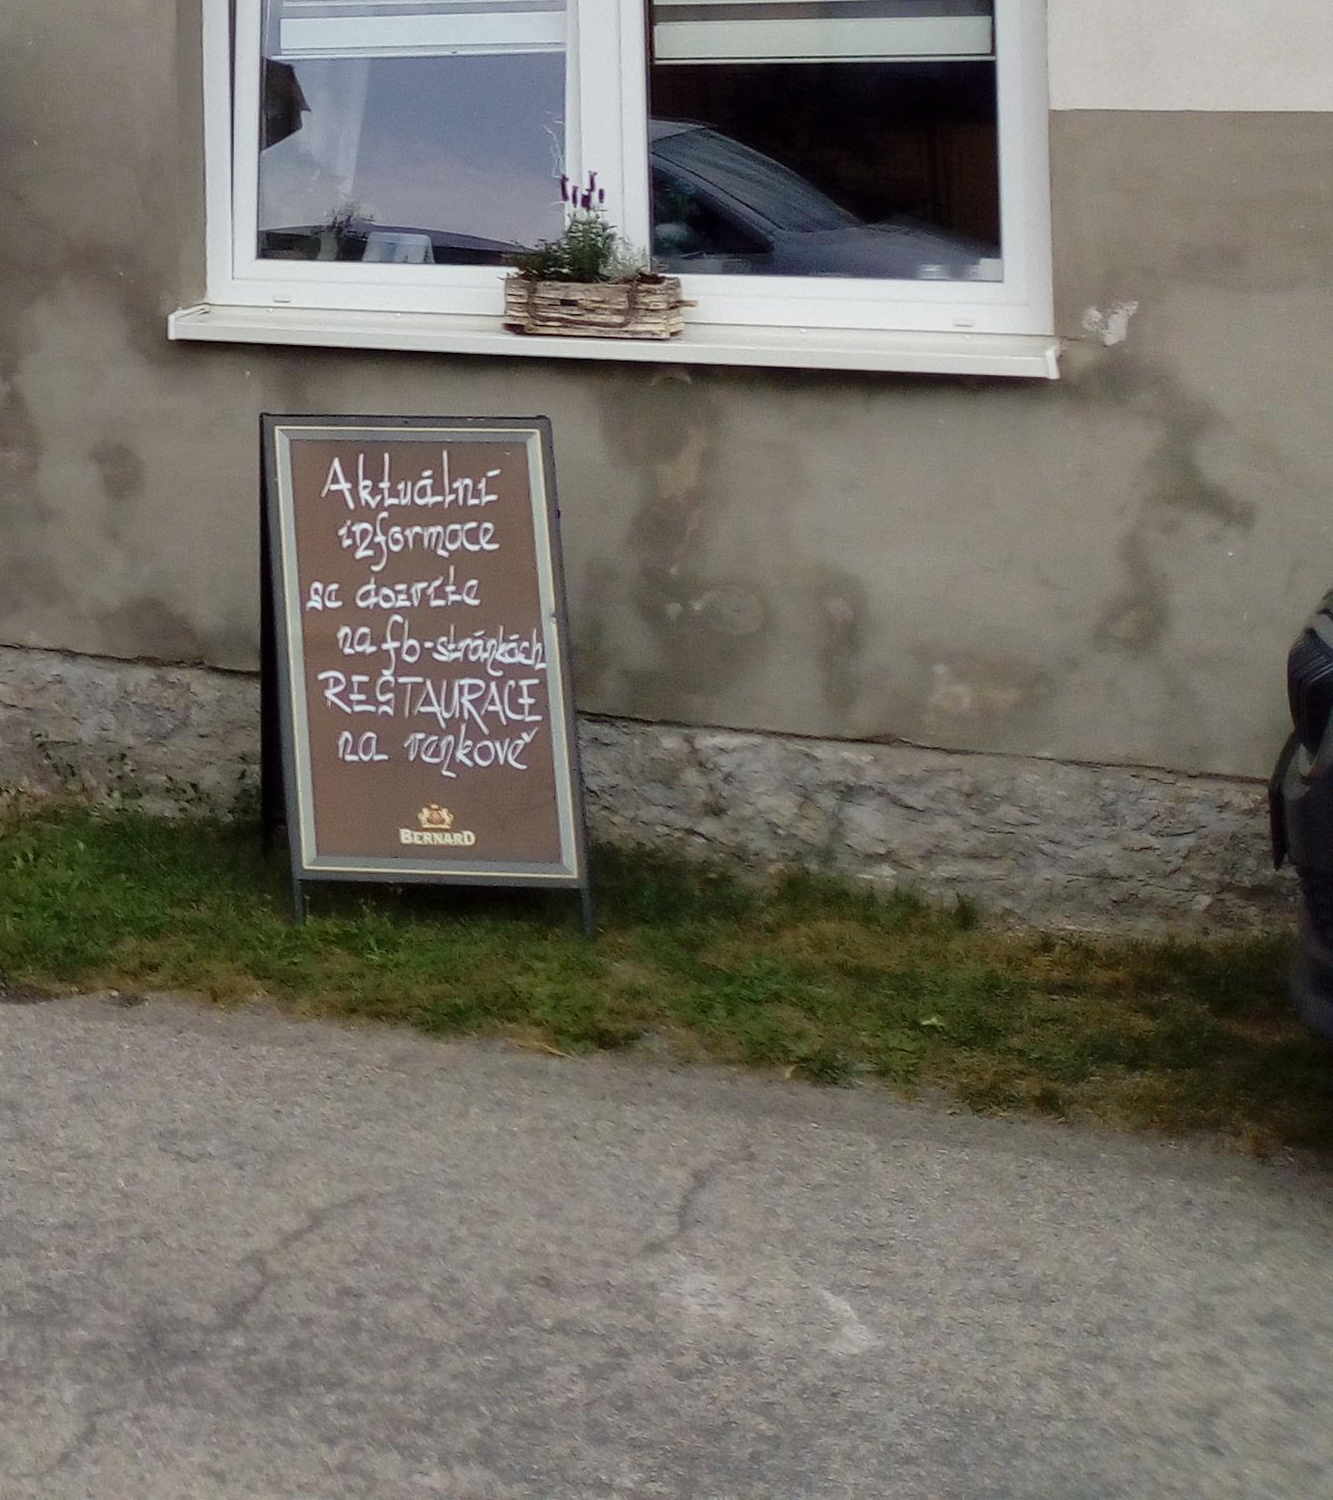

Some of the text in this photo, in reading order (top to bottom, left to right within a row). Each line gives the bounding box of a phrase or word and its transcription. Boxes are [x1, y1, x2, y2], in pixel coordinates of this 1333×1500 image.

[321, 450, 501, 510] Aktuální
[338, 511, 500, 572] informace
[306, 565, 481, 611] se dozvíte
[337, 626, 377, 655] na
[317, 670, 542, 735] RESTAURACE
[338, 723, 539, 778] na venkově
[399, 828, 476, 847] BERNARD
